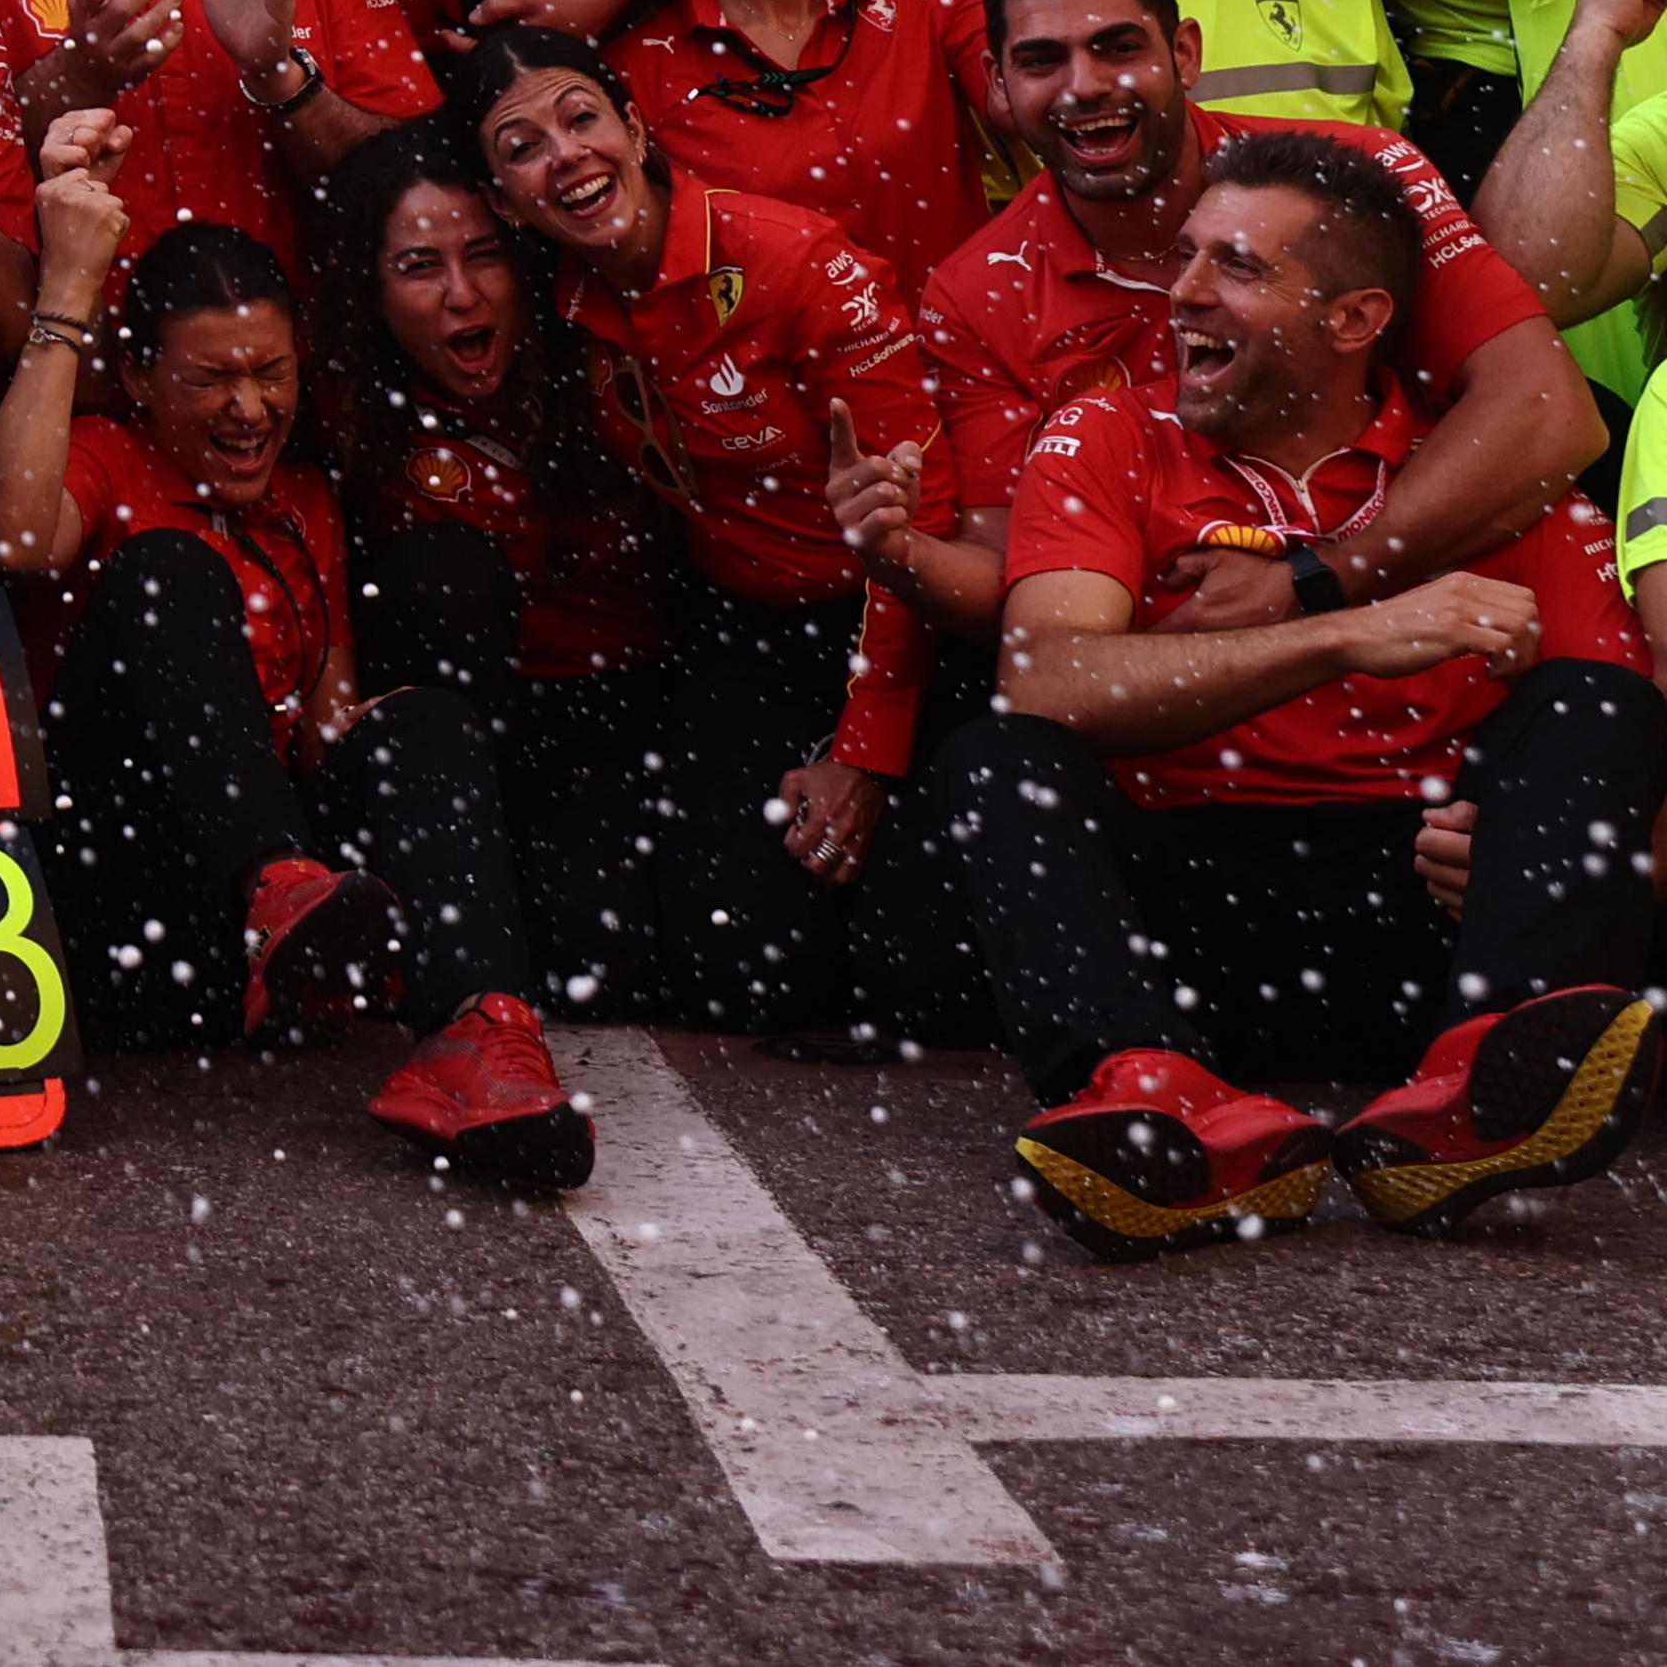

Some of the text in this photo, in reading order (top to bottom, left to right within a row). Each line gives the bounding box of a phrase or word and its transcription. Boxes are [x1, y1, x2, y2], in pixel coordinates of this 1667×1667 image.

[1374, 141, 1418, 168] aws
[825, 250, 856, 279] aws
[849, 333, 917, 378] HCLSoftware
[700, 388, 769, 415] Santander
